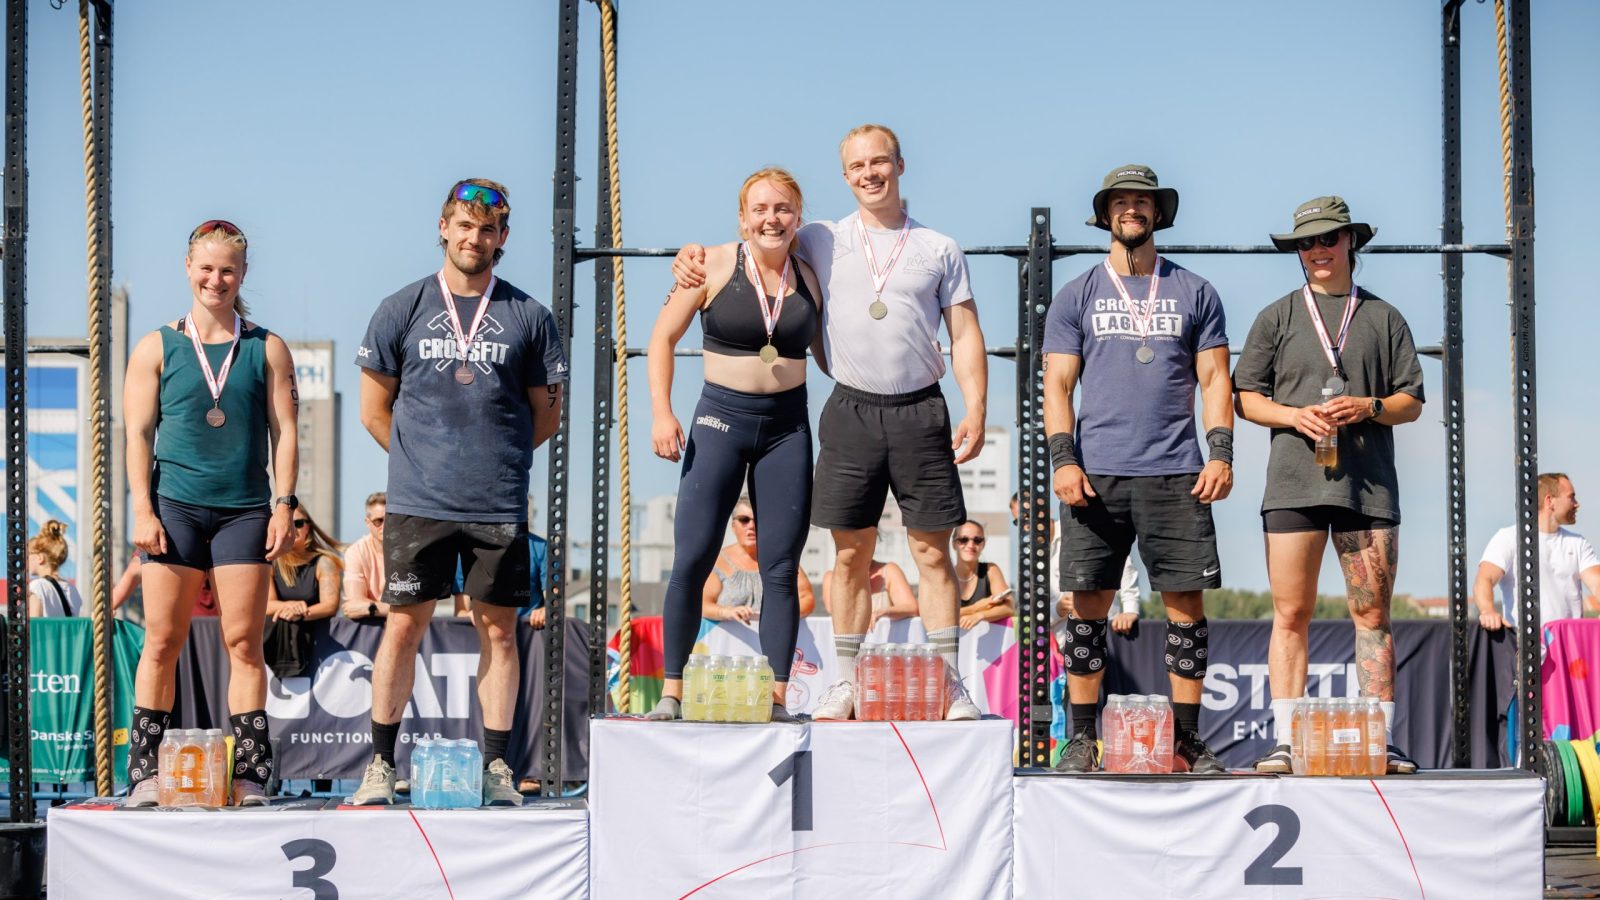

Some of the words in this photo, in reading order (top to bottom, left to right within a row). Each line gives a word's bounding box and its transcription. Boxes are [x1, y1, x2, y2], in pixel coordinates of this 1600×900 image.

[1116, 170, 1145, 178] ROGUE
[1095, 298, 1178, 312] CROSSFIT
[445, 331, 484, 341] AAHUS
[30, 730, 81, 741] Danske
[768, 750, 813, 831] 1
[1243, 804, 1303, 885] 2
[280, 838, 339, 900] 3
